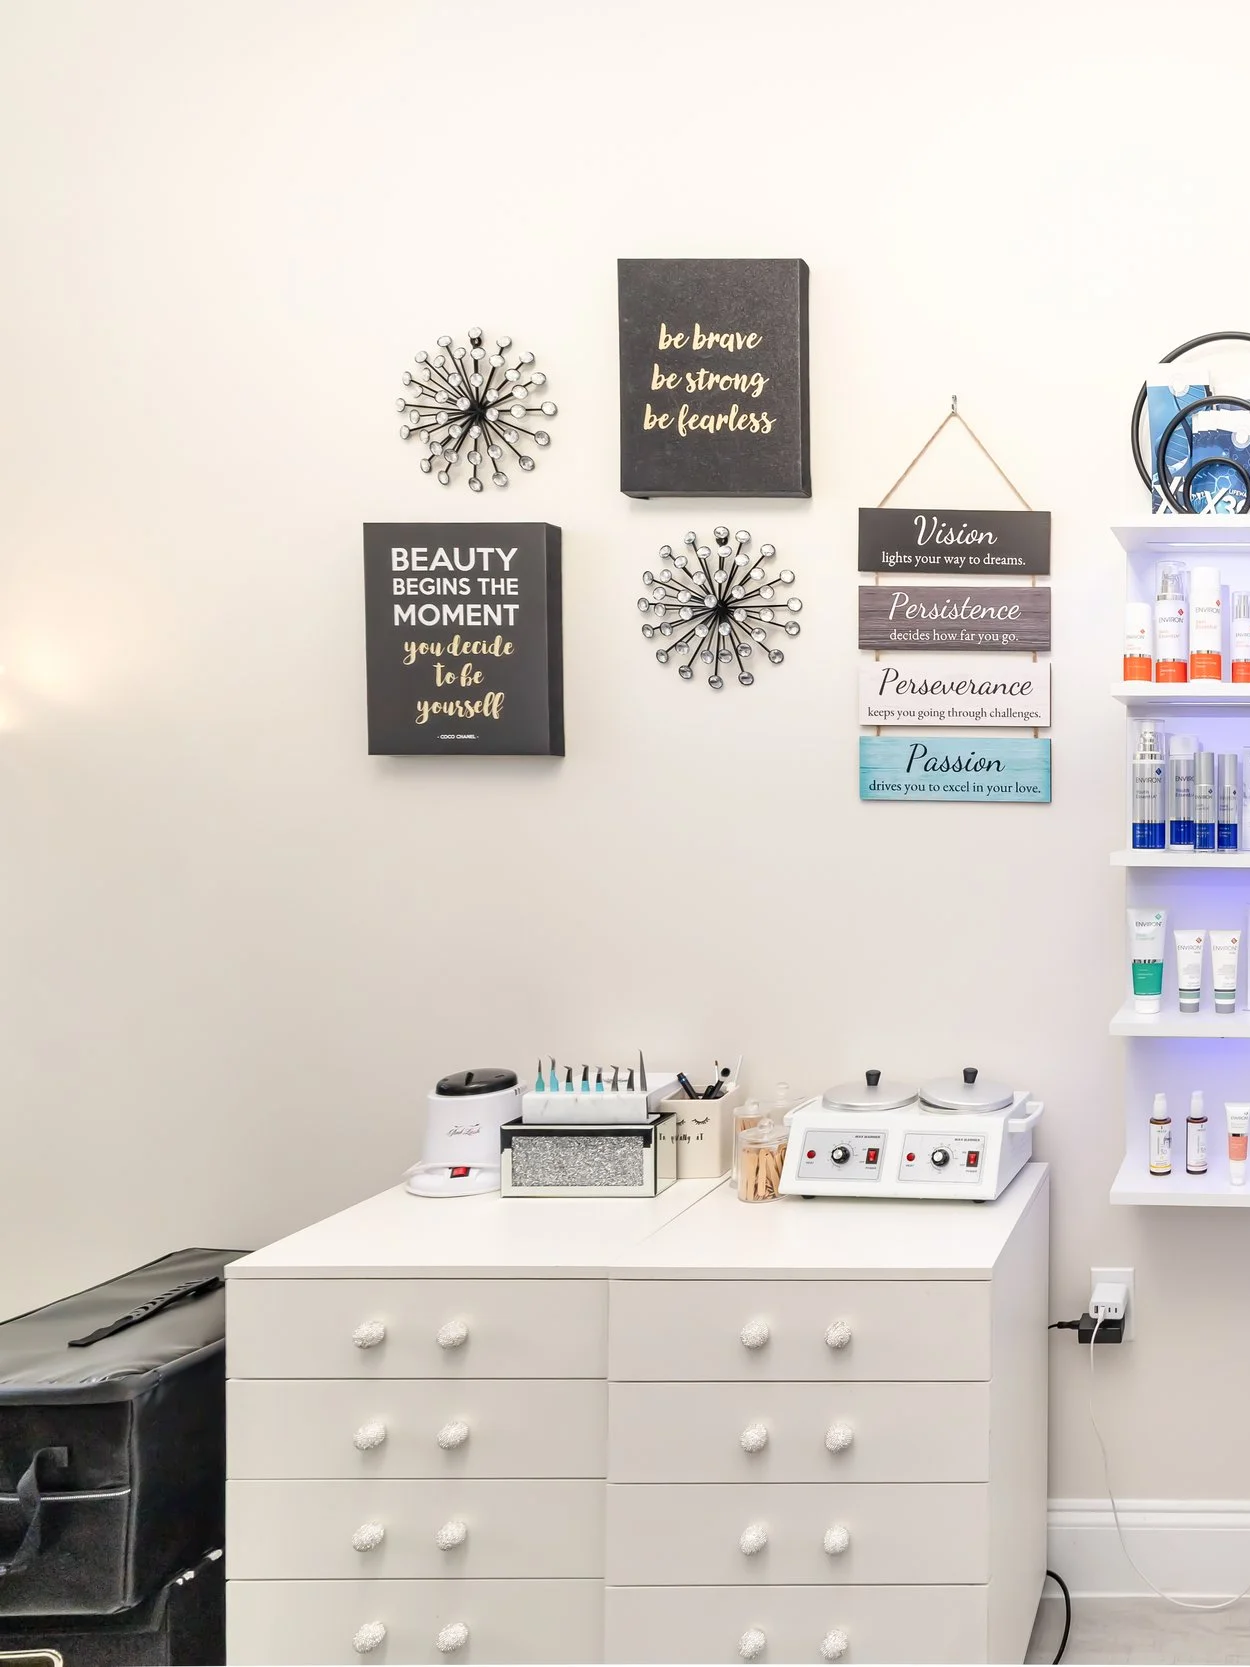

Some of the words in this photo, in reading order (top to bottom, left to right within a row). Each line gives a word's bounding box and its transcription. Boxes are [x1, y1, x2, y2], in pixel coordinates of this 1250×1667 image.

[659, 323, 689, 350] be
[692, 323, 762, 352] brave
[651, 363, 682, 390] be
[686, 368, 769, 398] strong
[644, 404, 674, 430] be
[678, 404, 776, 437] fearless
[914, 515, 998, 546] Vision
[391, 547, 518, 571] BEAUTY
[881, 551, 912, 566] lights
[915, 555, 942, 568] your
[944, 555, 966, 568] way
[969, 555, 981, 565] to
[983, 554, 1026, 566] dreams.
[393, 578, 471, 595] BEGINS
[477, 578, 519, 595] THE
[394, 604, 519, 626] MOMENT
[888, 592, 1021, 621] Persistence
[403, 641, 445, 665] you
[447, 635, 514, 657] decide
[889, 629, 930, 642] decides
[933, 629, 958, 642] how
[960, 629, 976, 642] far
[978, 632, 999, 645] you
[1001, 633, 1018, 645] go.
[432, 663, 458, 687] to
[460, 663, 484, 687] be
[879, 667, 1033, 697] Perseverance
[415, 692, 504, 724] yourself
[867, 707, 895, 719] keeps
[897, 710, 916, 722] you
[918, 708, 945, 720] going
[947, 707, 987, 719] through
[990, 708, 1041, 720] challenges.
[906, 743, 1005, 773] Passion
[869, 780, 902, 792] drives
[903, 782, 926, 794] you
[929, 782, 940, 792] to
[943, 780, 969, 792] excel
[973, 781, 983, 793] in
[986, 783, 1013, 795] your
[1015, 783, 1041, 794] love.
